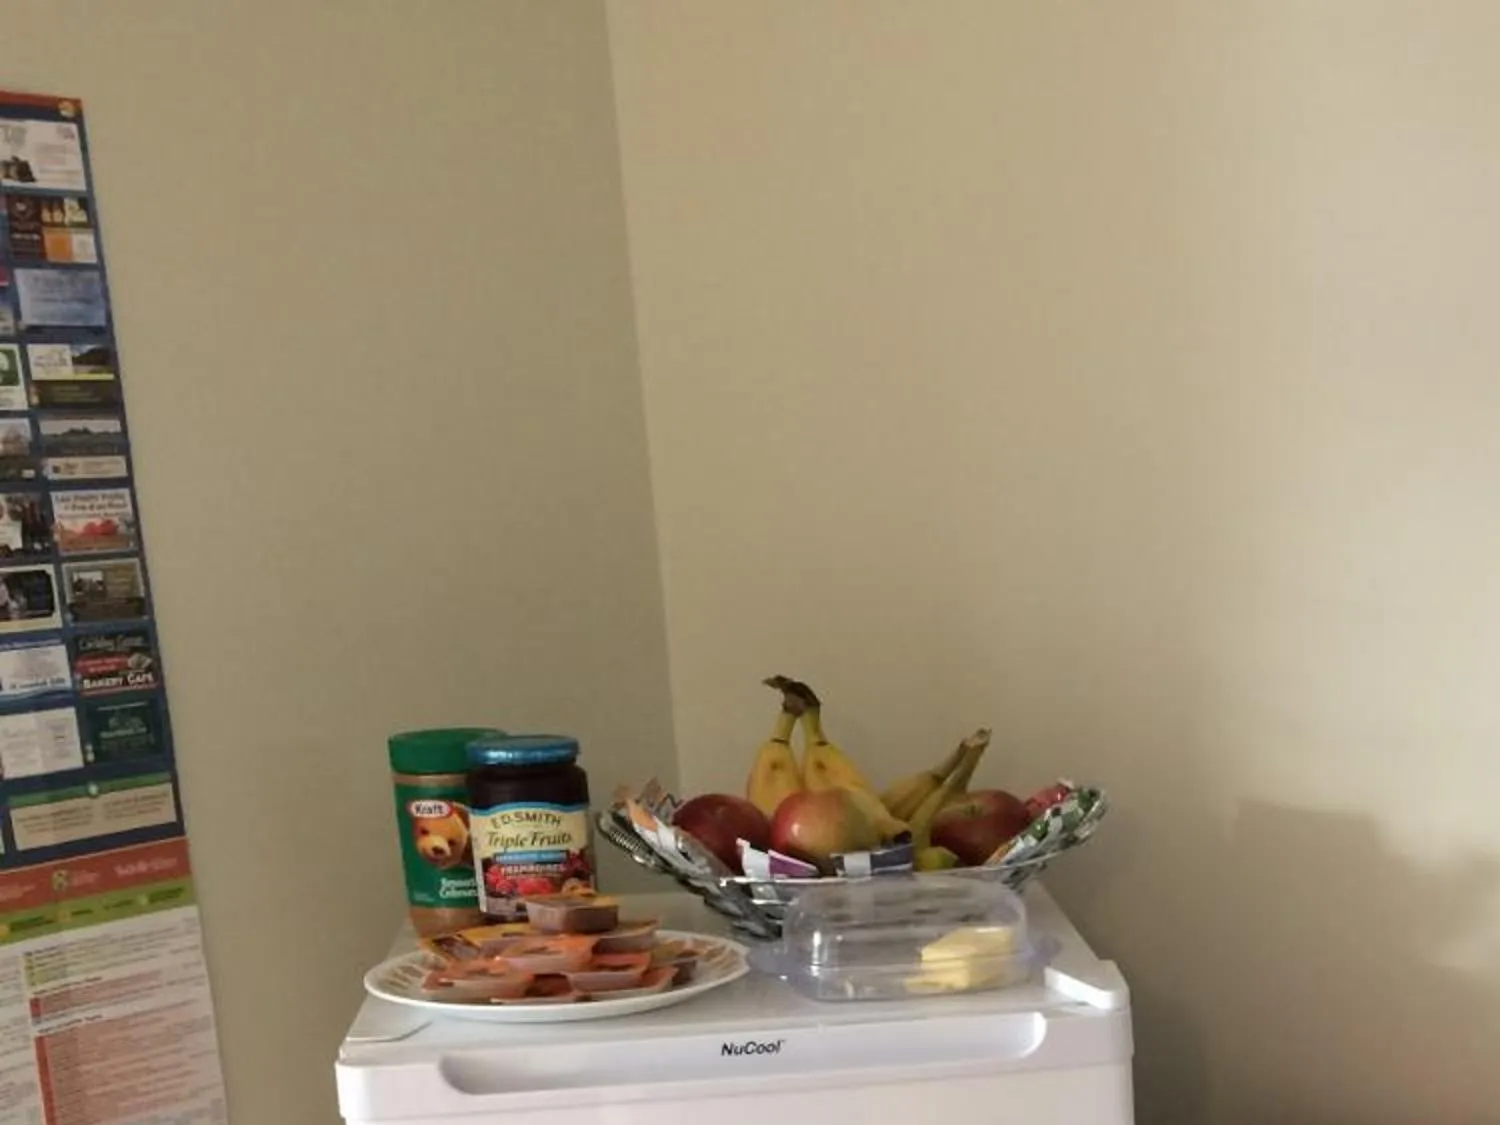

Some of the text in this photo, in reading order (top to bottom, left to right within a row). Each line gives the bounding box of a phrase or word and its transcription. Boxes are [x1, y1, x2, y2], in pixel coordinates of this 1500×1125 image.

[487, 831, 571, 850] Triple Fruits
[721, 1040, 781, 1057] NuCool
